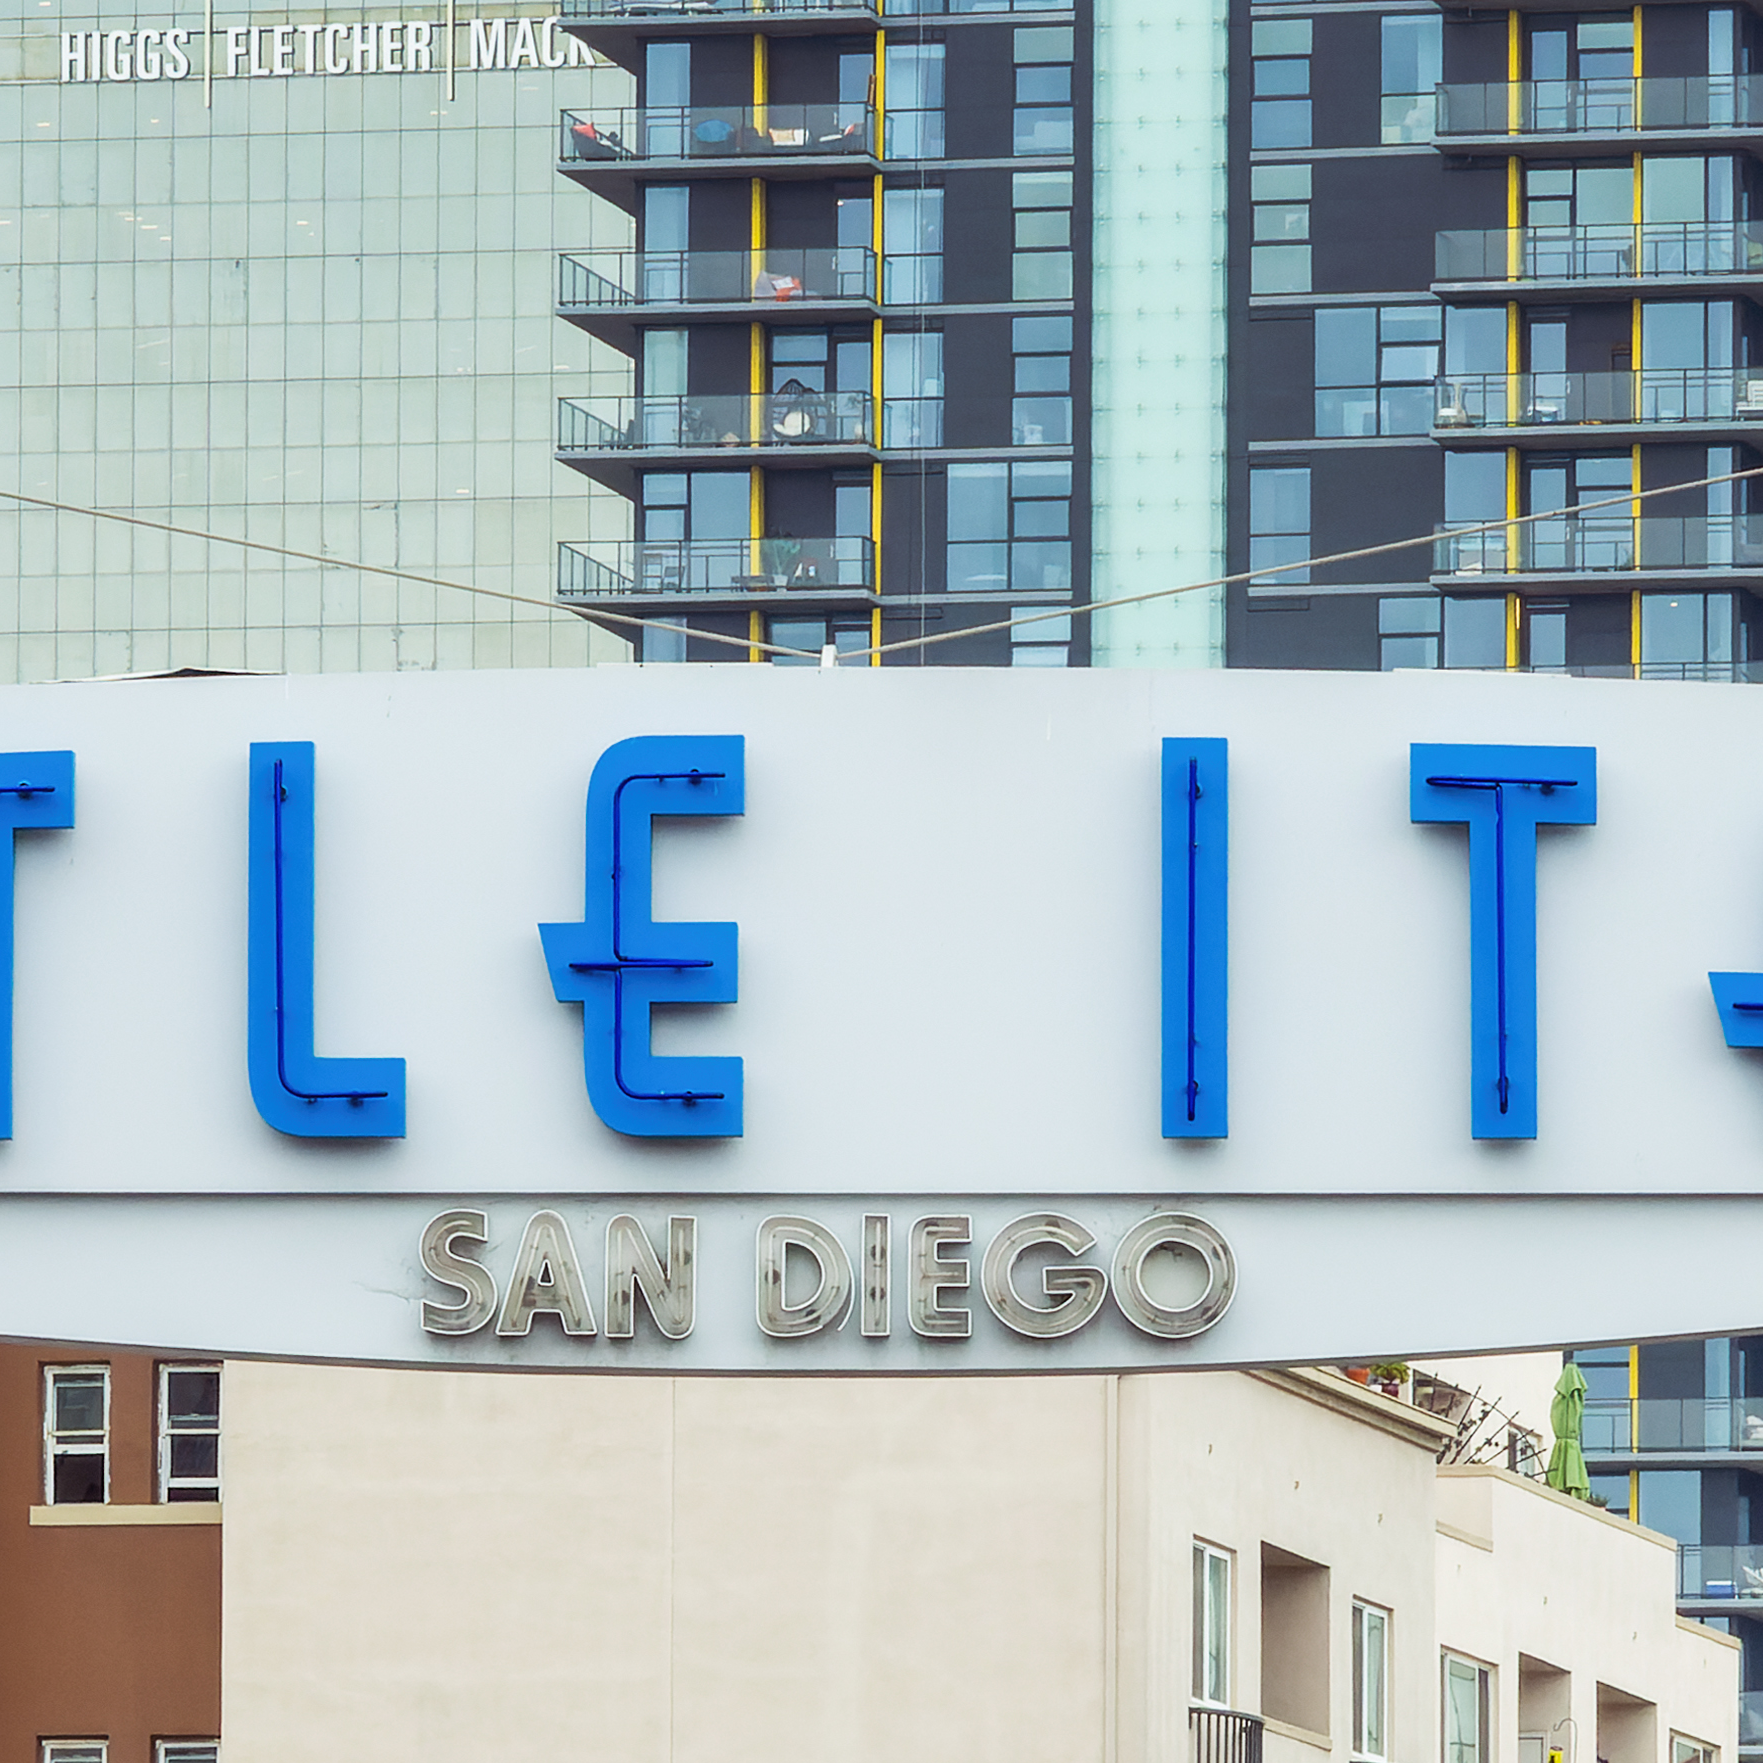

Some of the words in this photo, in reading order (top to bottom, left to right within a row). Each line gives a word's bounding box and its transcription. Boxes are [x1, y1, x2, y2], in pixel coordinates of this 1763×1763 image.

[59, 26, 192, 84] HIGGS
[226, 19, 435, 77] FLETCHER
[418, 1208, 699, 1340] SAN
[755, 1210, 1240, 1340] DIEGO
